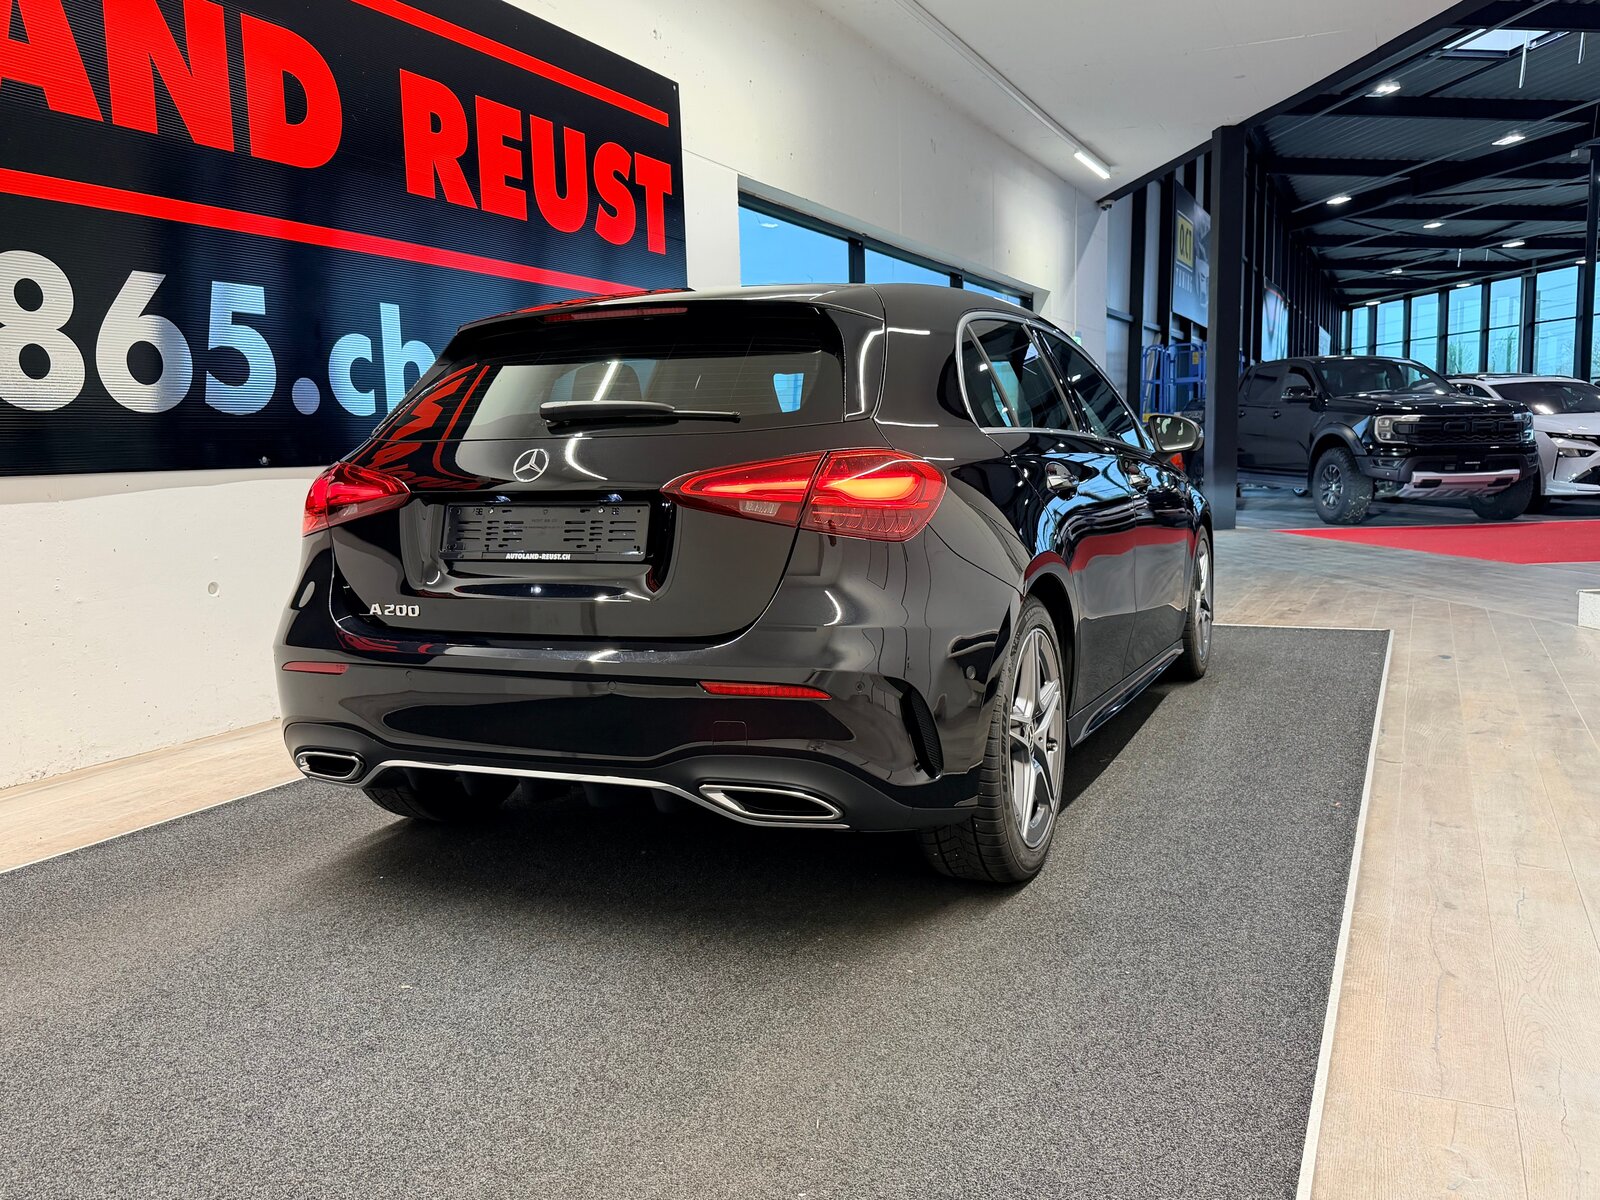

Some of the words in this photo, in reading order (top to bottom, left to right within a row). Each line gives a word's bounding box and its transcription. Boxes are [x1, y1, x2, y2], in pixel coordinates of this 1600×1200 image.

[0, 0, 342, 169] AND
[400, 68, 672, 255] REUST
[0, 250, 436, 417] 865.ch
[505, 552, 571, 561] AUTOLAND-REUST.CH
[369, 603, 382, 616] A
[384, 603, 420, 617] 200
